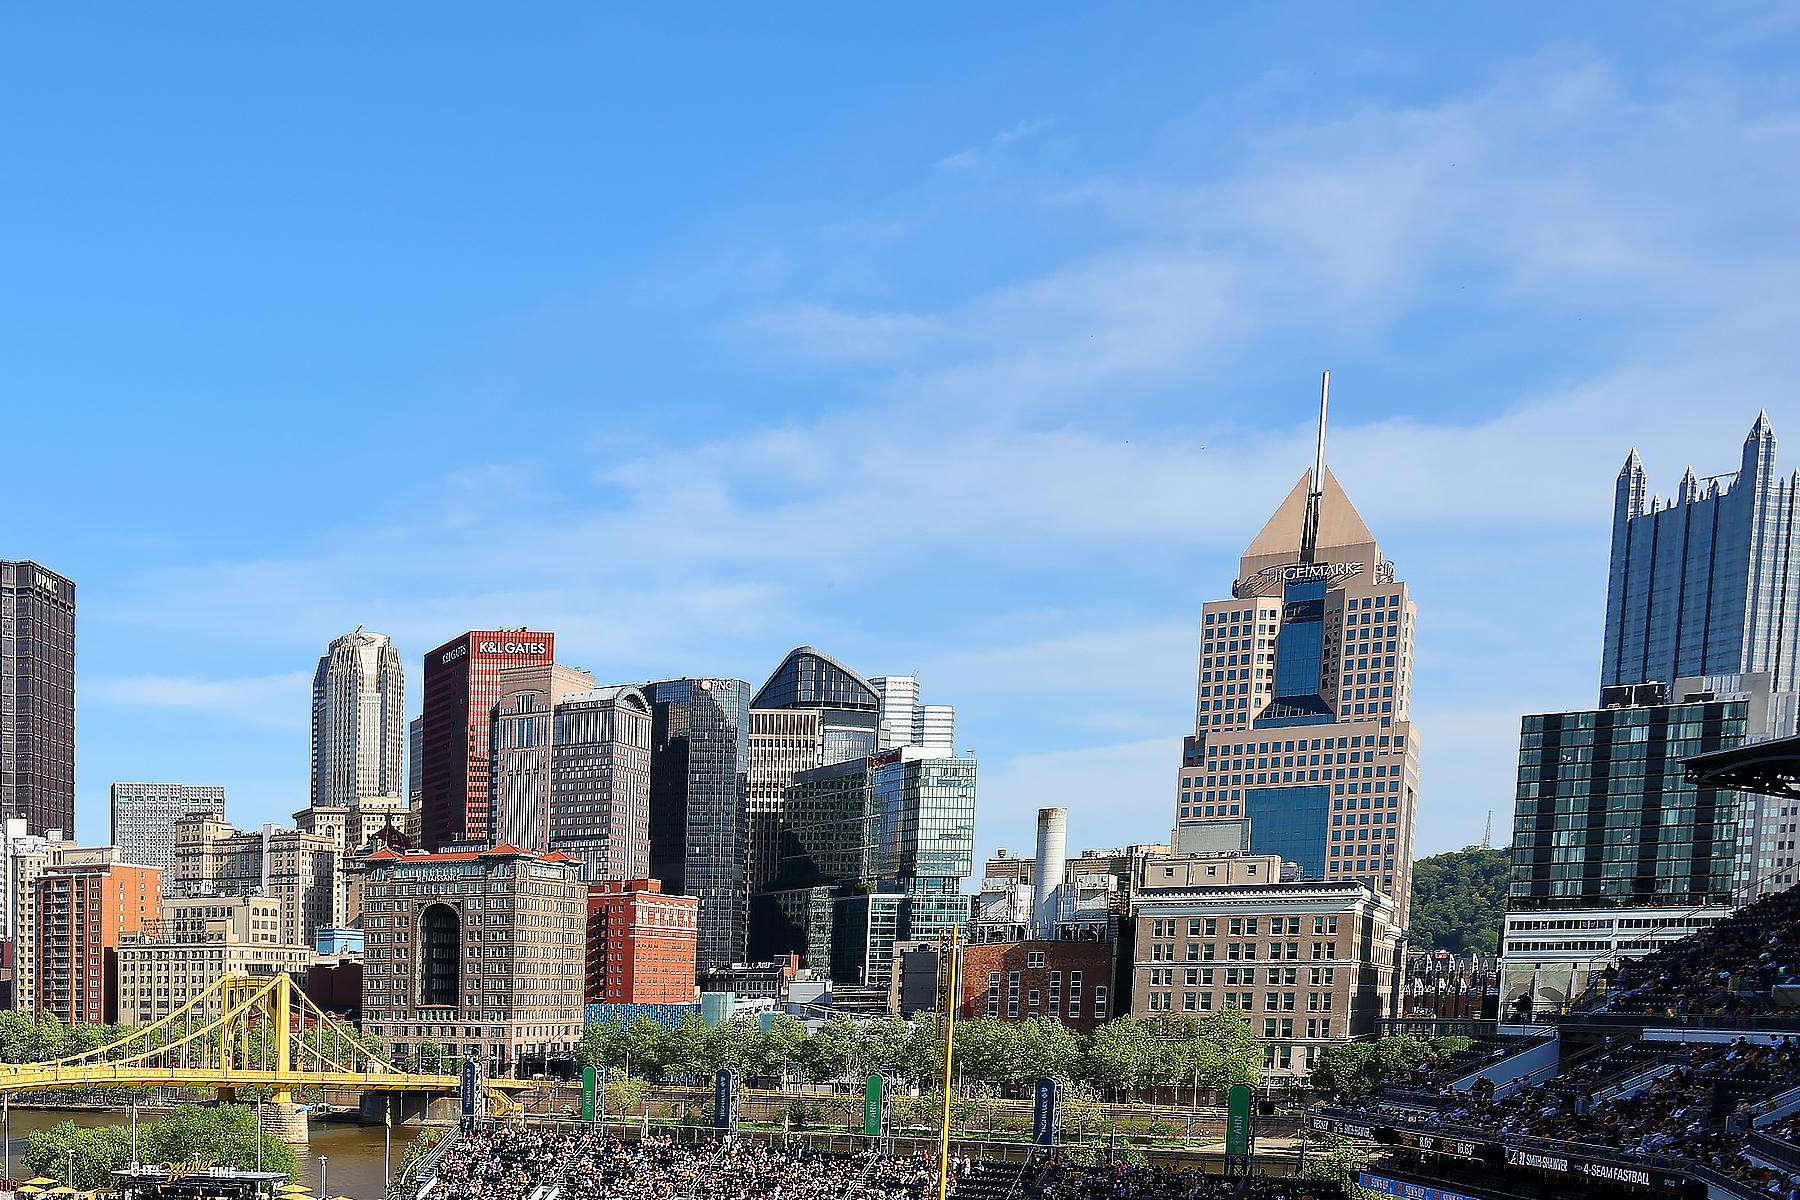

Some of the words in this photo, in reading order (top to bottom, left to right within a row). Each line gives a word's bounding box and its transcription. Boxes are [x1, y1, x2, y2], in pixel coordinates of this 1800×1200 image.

[34, 571, 58, 594] UPMC
[479, 641, 503, 655] K&L
[505, 641, 546, 655] GATES
[711, 679, 733, 691] PNC
[208, 1166, 237, 1179] TIME
[1583, 1162, 1613, 1178] 4-SEAM
[1613, 1166, 1650, 1186] FASTBALL
